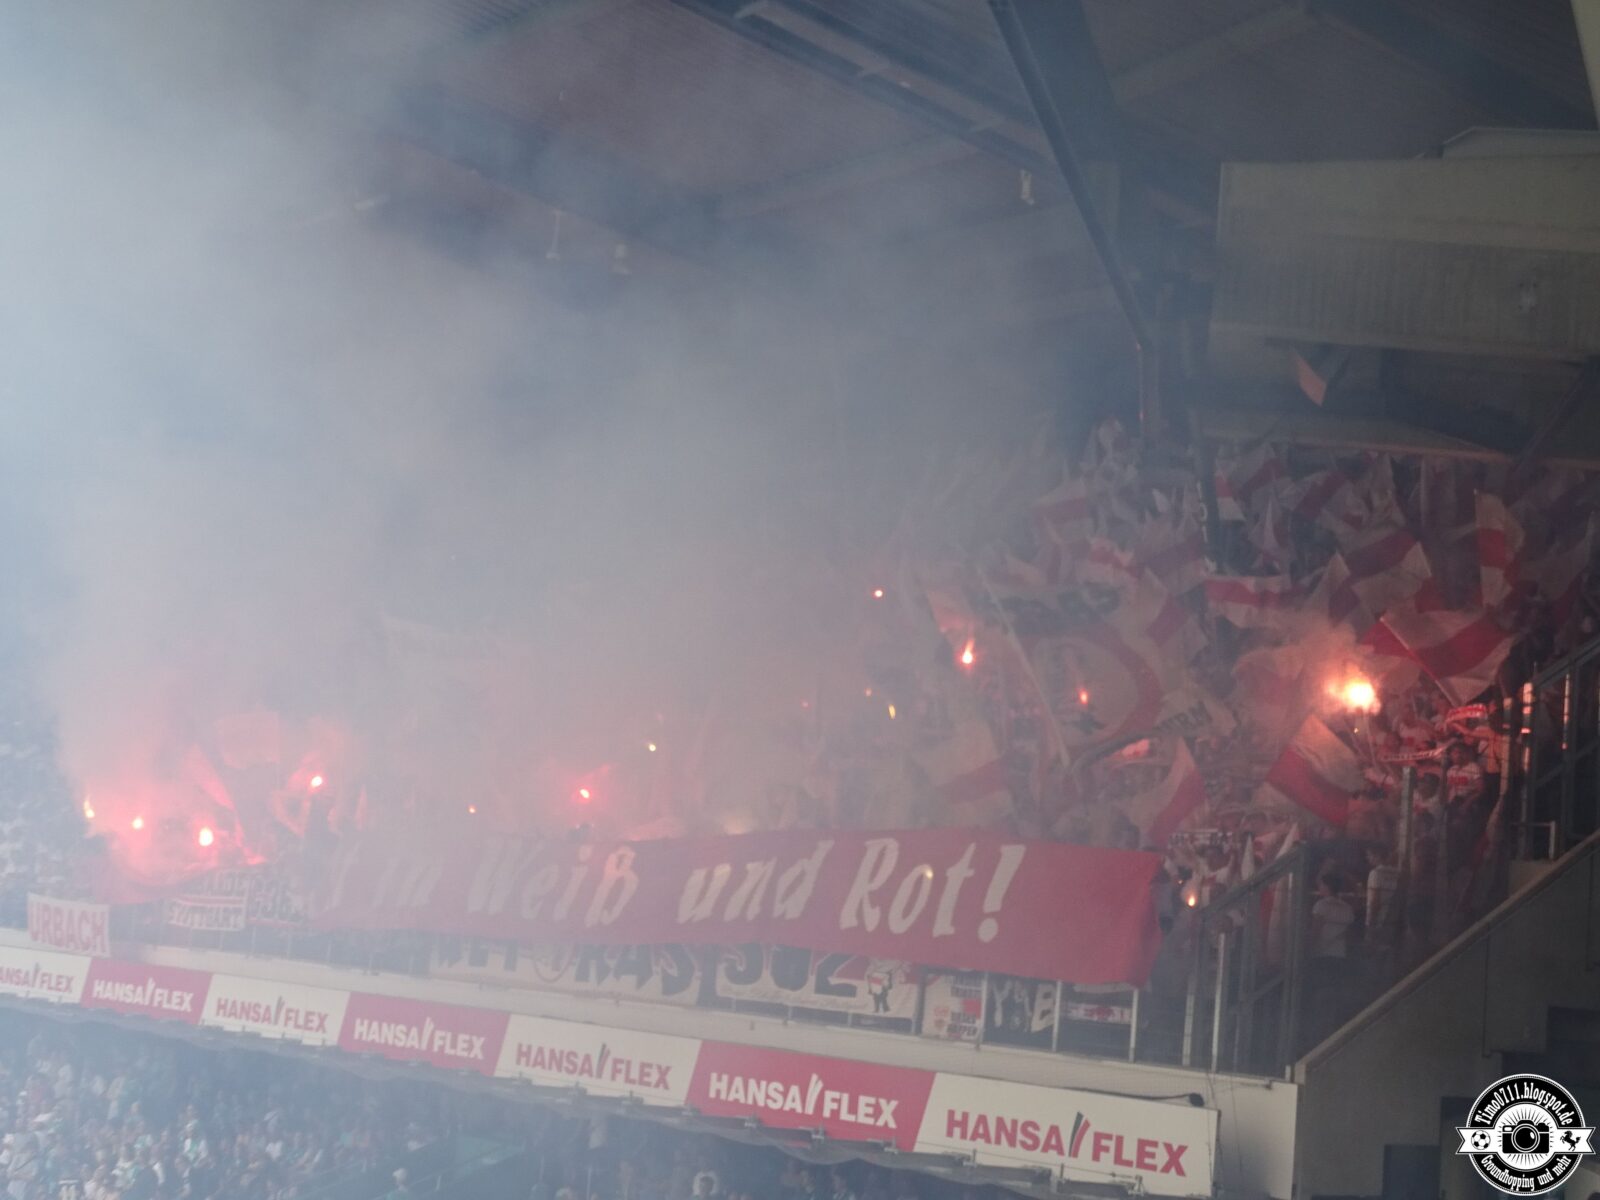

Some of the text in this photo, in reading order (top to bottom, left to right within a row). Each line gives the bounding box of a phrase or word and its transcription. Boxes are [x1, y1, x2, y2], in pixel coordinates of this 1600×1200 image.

[676, 839, 835, 925] und
[839, 837, 1026, 943] Rot!
[30, 900, 106, 953] URBACH
[0, 966, 75, 993] ANSA FLEX
[93, 979, 194, 1013] HANSA FLEX
[216, 997, 328, 1034] HANSA FLEX
[354, 1017, 485, 1060] HANSA FLEX
[516, 1042, 672, 1090] HANSA FLEX
[708, 1072, 898, 1129] HANSA FLEX
[945, 1109, 1189, 1177] HANSA FLEX
